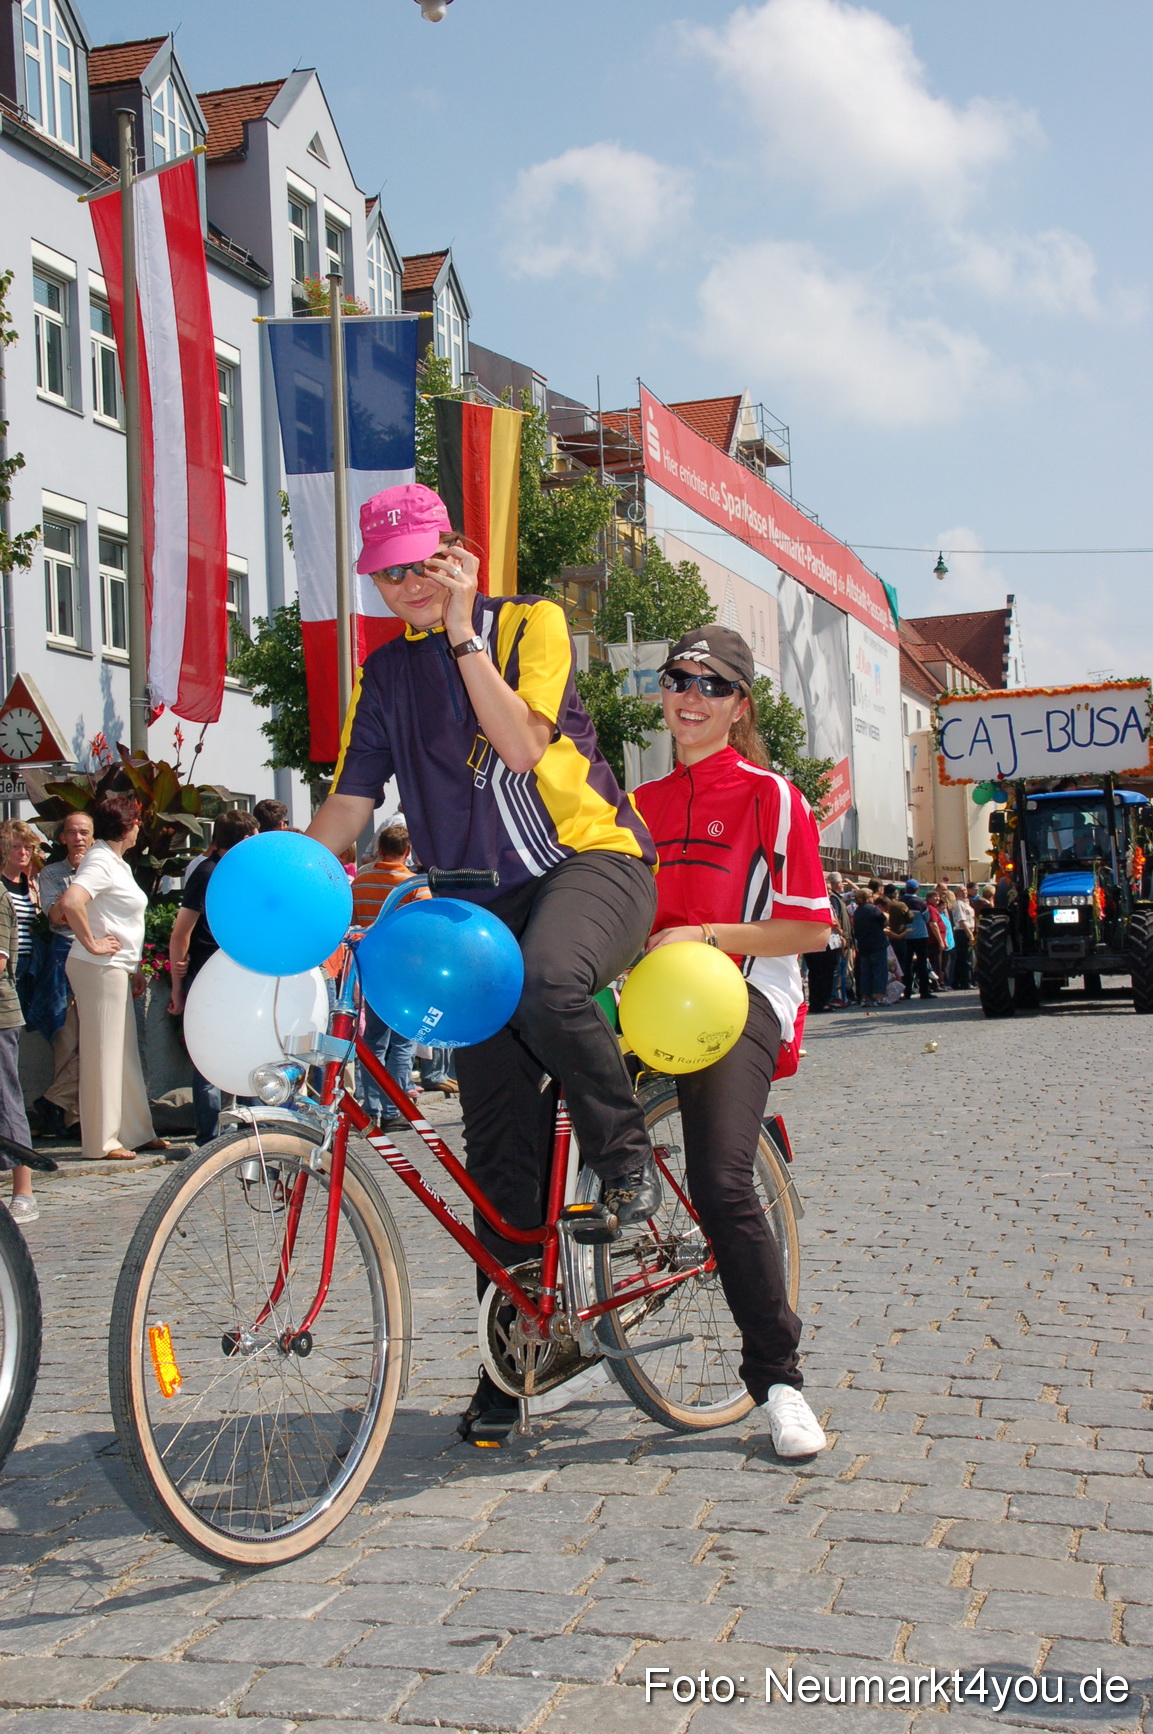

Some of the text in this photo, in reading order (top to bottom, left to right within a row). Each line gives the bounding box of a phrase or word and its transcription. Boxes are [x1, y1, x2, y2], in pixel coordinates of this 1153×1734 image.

[663, 446, 678, 477] Hier
[680, 465, 709, 500] errichtet
[709, 481, 721, 507] die
[720, 481, 768, 539] Sparkasse
[768, 514, 837, 595] Neumarkt-Parsberg
[940, 703, 1146, 777] CAJ-BÜSA
